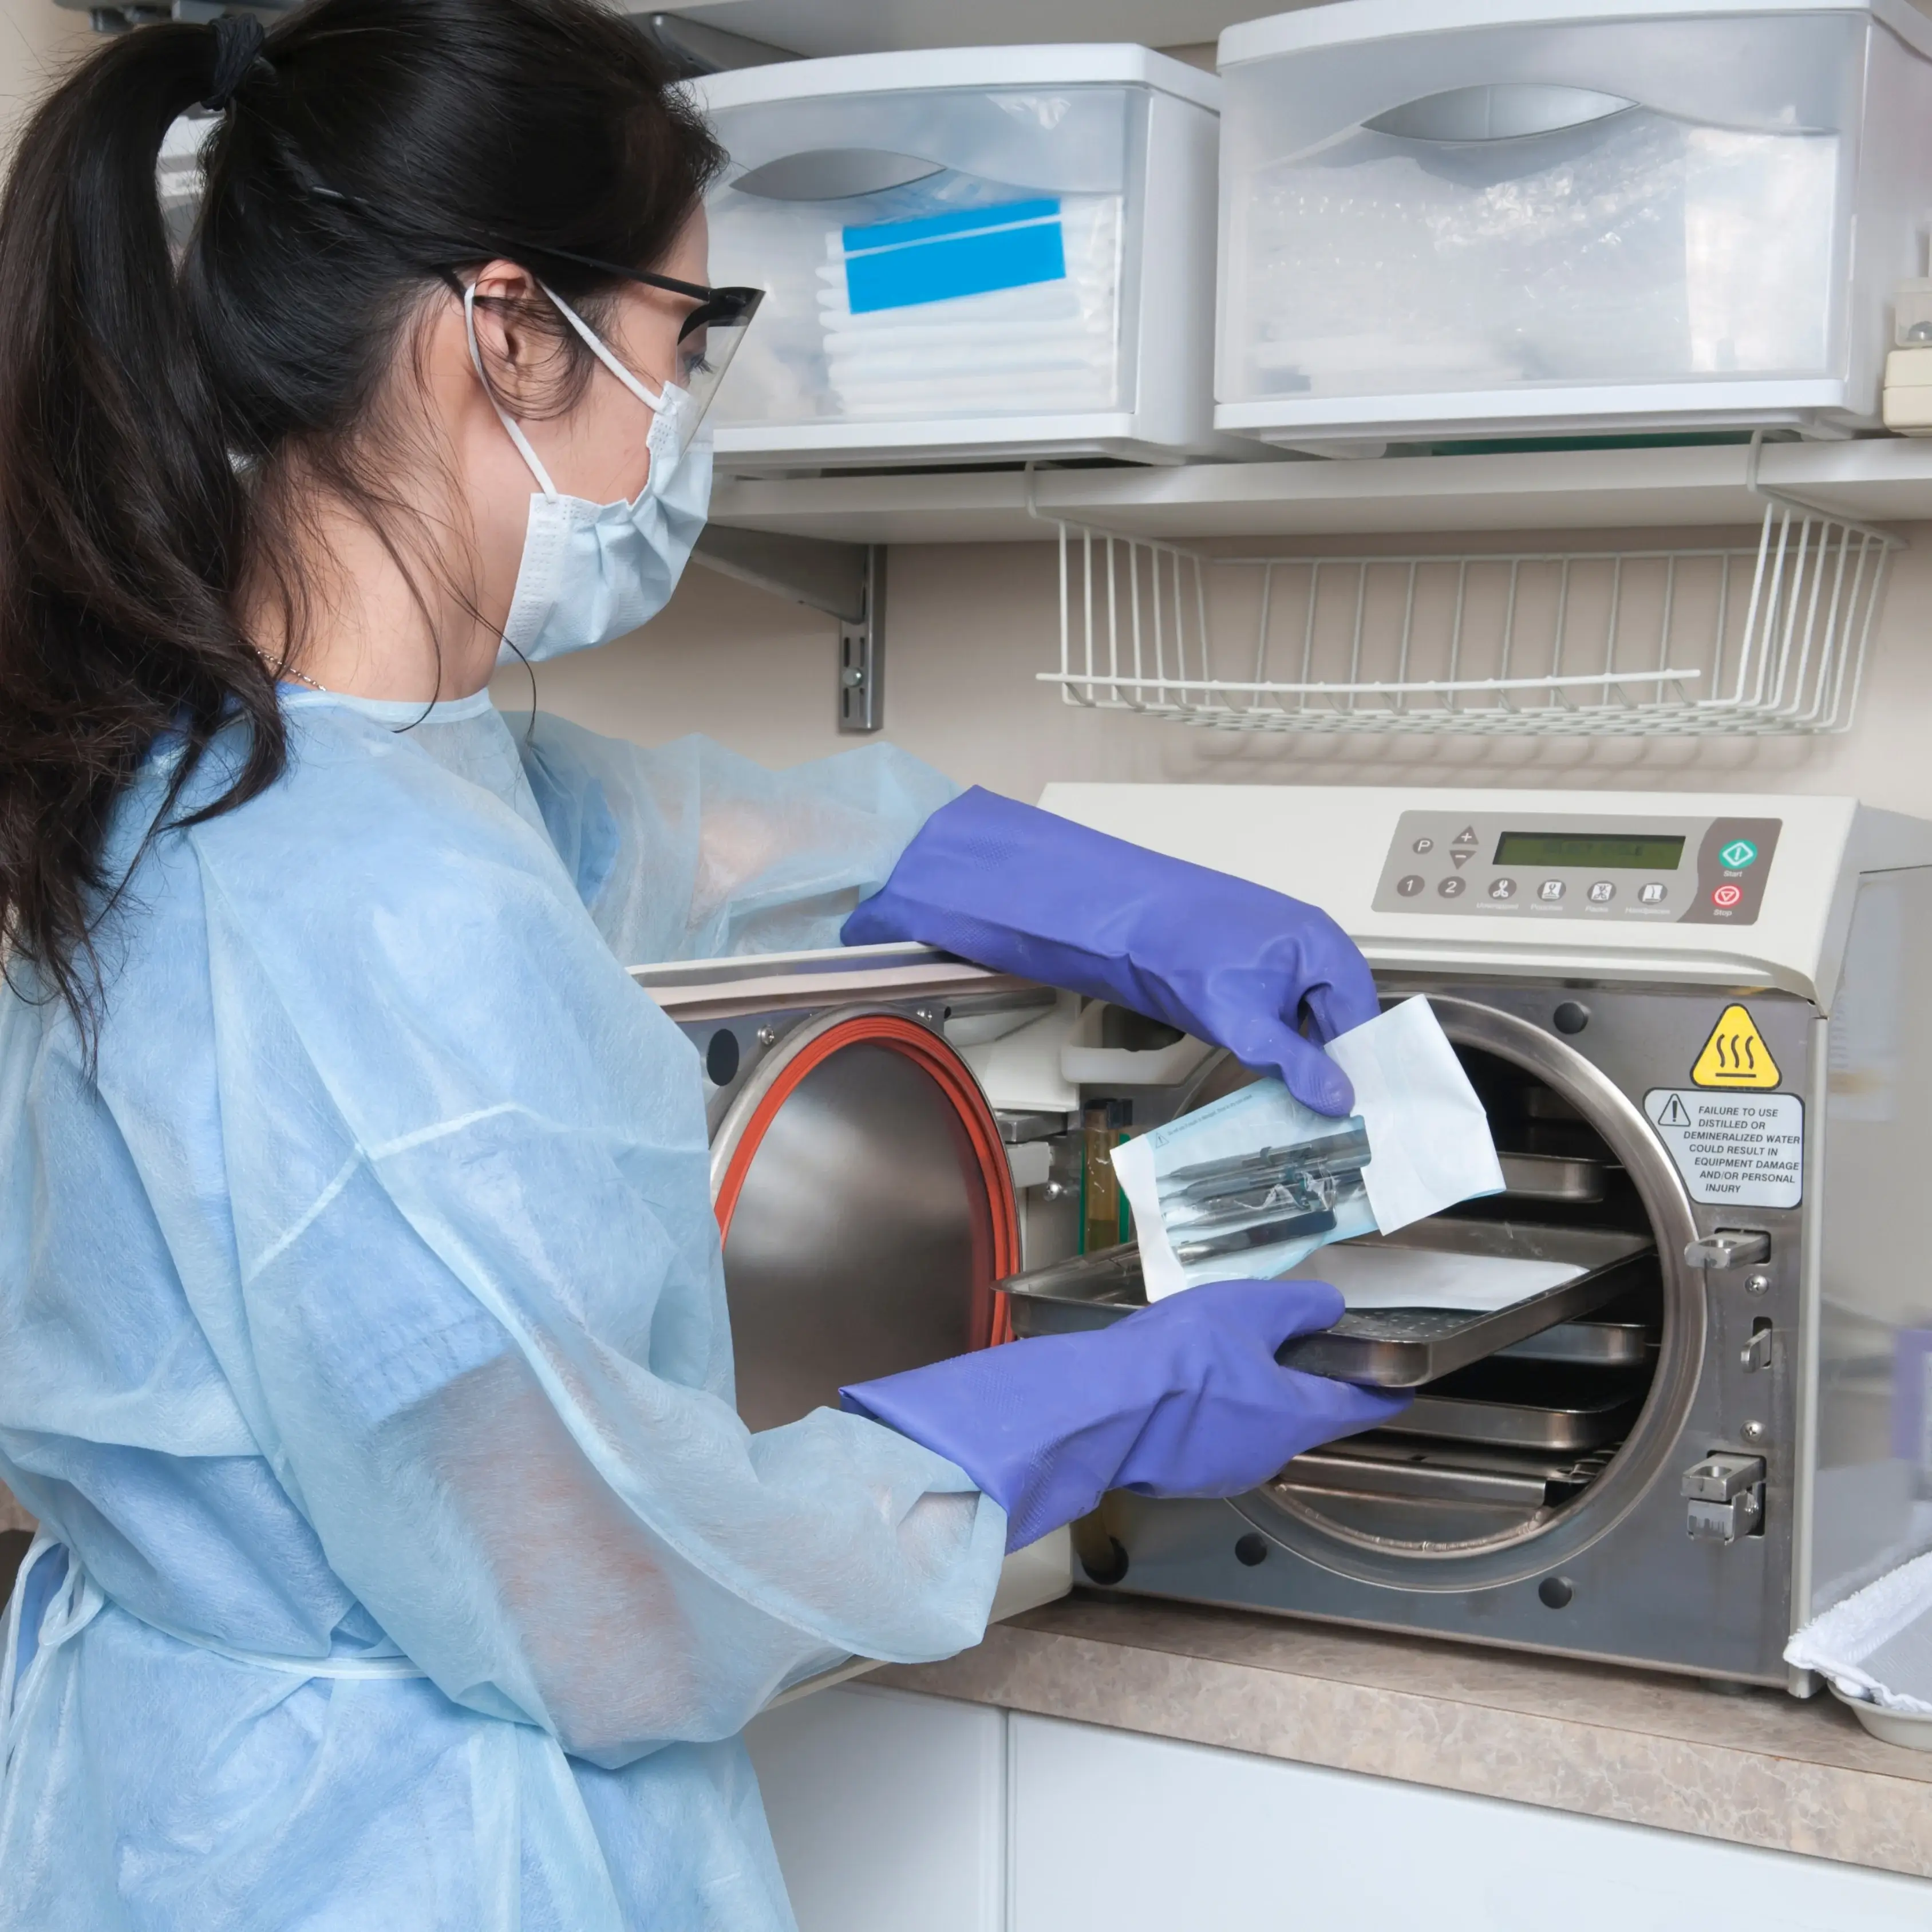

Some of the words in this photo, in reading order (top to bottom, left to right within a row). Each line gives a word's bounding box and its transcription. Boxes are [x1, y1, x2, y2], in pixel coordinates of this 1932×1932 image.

[1417, 840, 1431, 852] P
[1406, 879, 1414, 891] 1
[1445, 880, 1457, 893] 2
[1713, 908, 1732, 917] Stop
[1698, 1106, 1739, 1116] FAILURE
[1743, 1108, 1756, 1116] TO
[1759, 1109, 1779, 1117] USE
[1698, 1119, 1748, 1129] DISTILLED
[1751, 1121, 1765, 1129] OR
[1684, 1131, 1763, 1142] DEMINERALIZED
[1766, 1135, 1800, 1144] WATER
[1689, 1144, 1724, 1153] COULD
[1727, 1146, 1765, 1155] RESULT
[1767, 1148, 1778, 1156] IN
[1694, 1157, 1753, 1168] EQUIPMENT
[1756, 1160, 1800, 1170] DAMAGE
[1700, 1171, 1739, 1180] AND/OR
[1741, 1173, 1795, 1183] PERSONAL
[1705, 1183, 1741, 1193] INJURY
